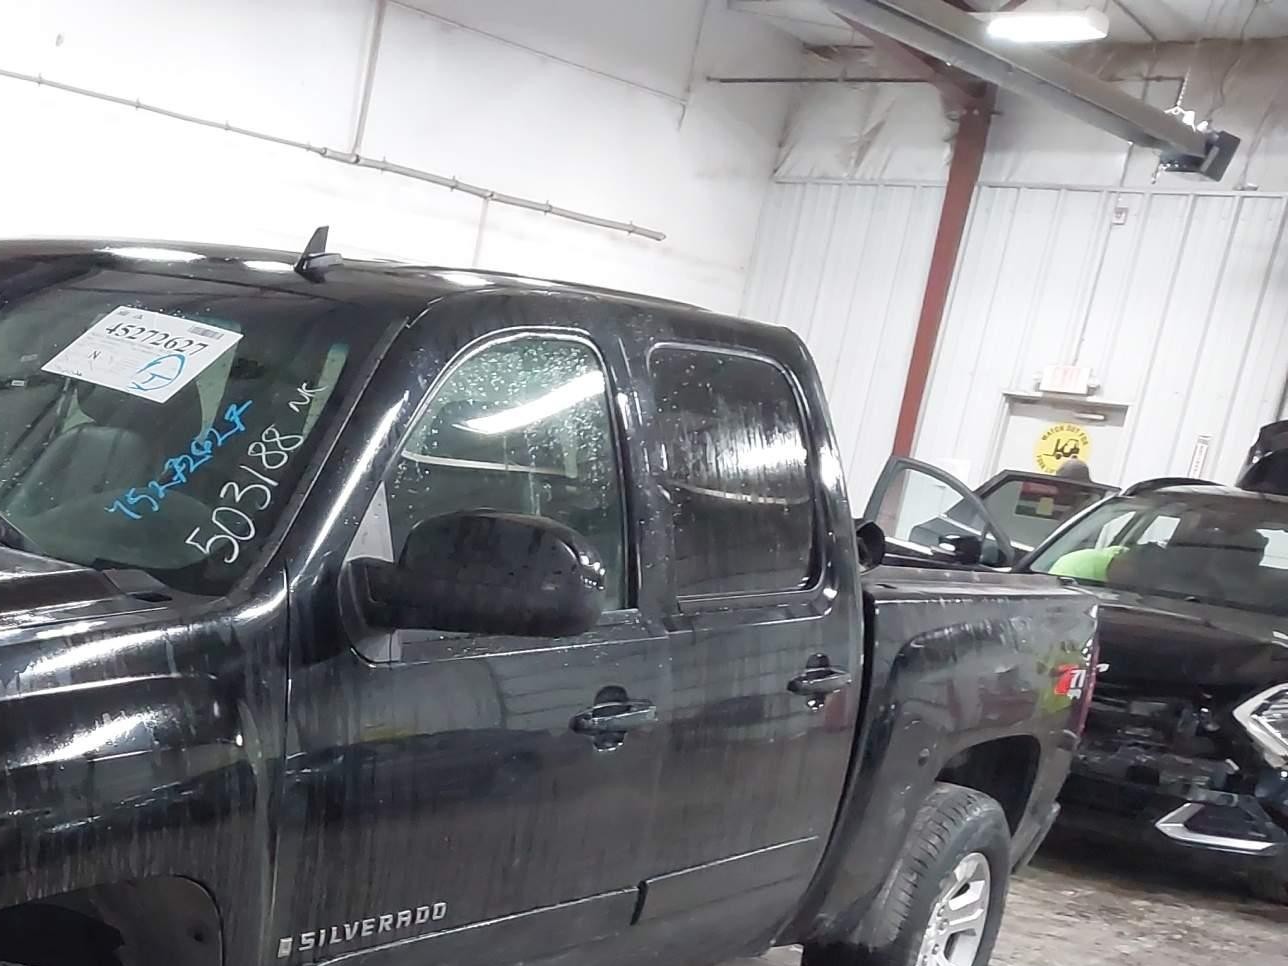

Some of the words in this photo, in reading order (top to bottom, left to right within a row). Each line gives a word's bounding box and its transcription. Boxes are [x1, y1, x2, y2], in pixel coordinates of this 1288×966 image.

[105, 323, 209, 356] 45272627
[185, 424, 305, 564] 503188
[298, 902, 447, 951] SILVERADO
